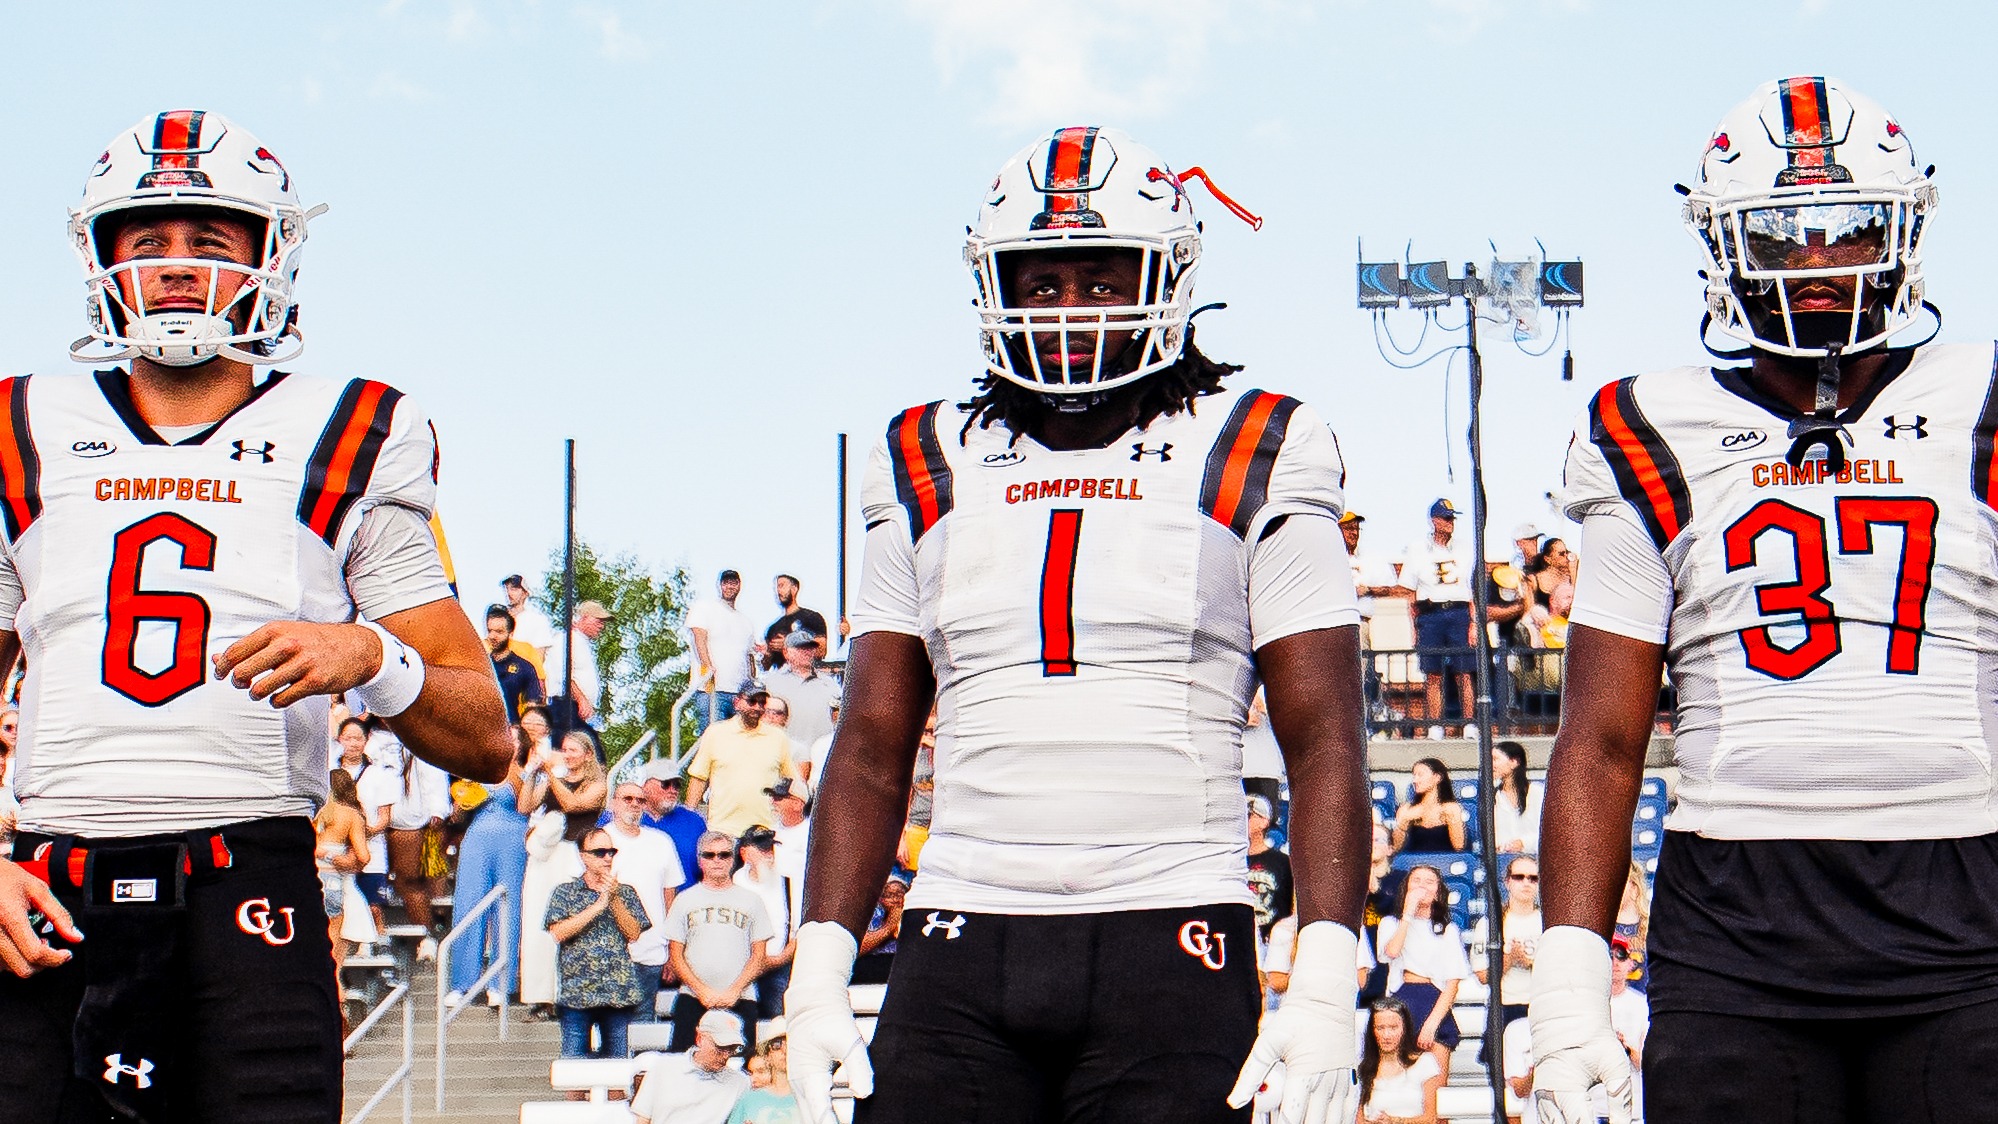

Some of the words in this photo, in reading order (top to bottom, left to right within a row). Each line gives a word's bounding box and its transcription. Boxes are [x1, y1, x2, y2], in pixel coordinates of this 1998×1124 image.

[71, 441, 108, 452] CAA
[1721, 431, 1759, 448] CAA
[983, 452, 1018, 463] CAA
[95, 477, 242, 503] CAMPBELL
[1005, 478, 1143, 504] CAMPBELL
[1039, 508, 1084, 678] 1
[1722, 496, 1940, 681] 37
[101, 511, 218, 708] 6
